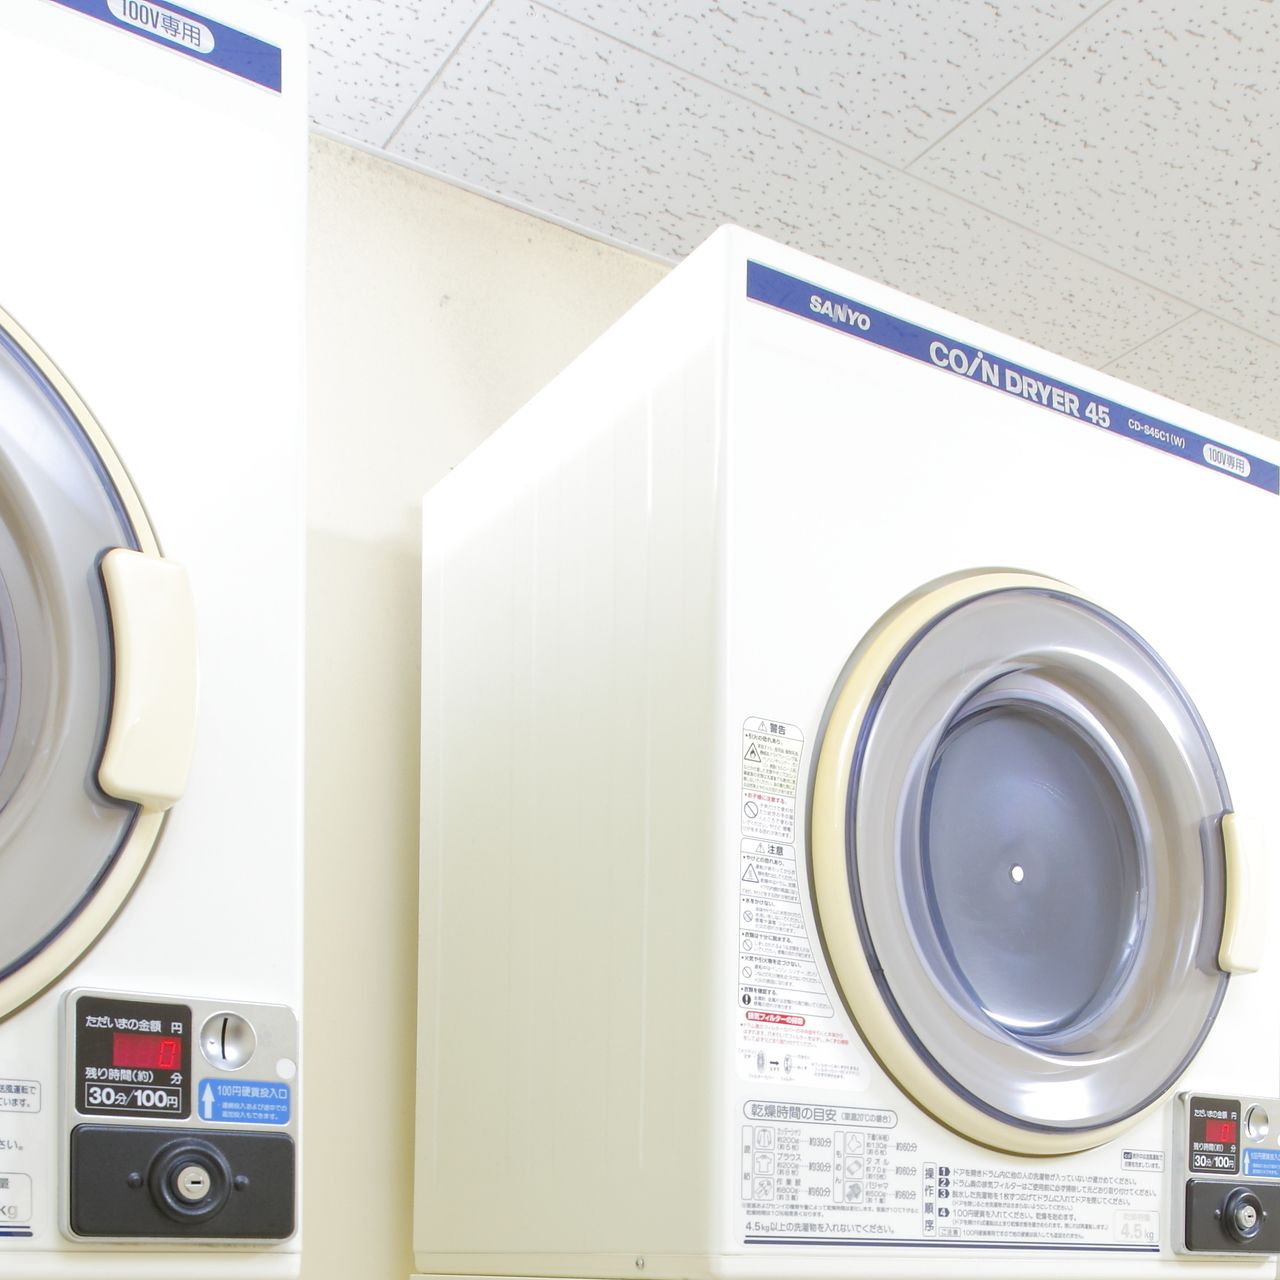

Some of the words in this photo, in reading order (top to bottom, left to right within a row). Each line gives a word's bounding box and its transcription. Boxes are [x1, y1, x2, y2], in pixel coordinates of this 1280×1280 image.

[122, 0, 201, 47] 100V専用
[809, 294, 871, 331] SANYO
[1004, 367, 1080, 418] DRYER
[1084, 400, 1110, 428] 45
[1208, 446, 1246, 475] 100V専用
[85, 1015, 162, 1033] ただいまの金額
[171, 1022, 183, 1034] 円
[170, 1072, 183, 1085] 分
[751, 1103, 837, 1122] 乾燥時間の目安
